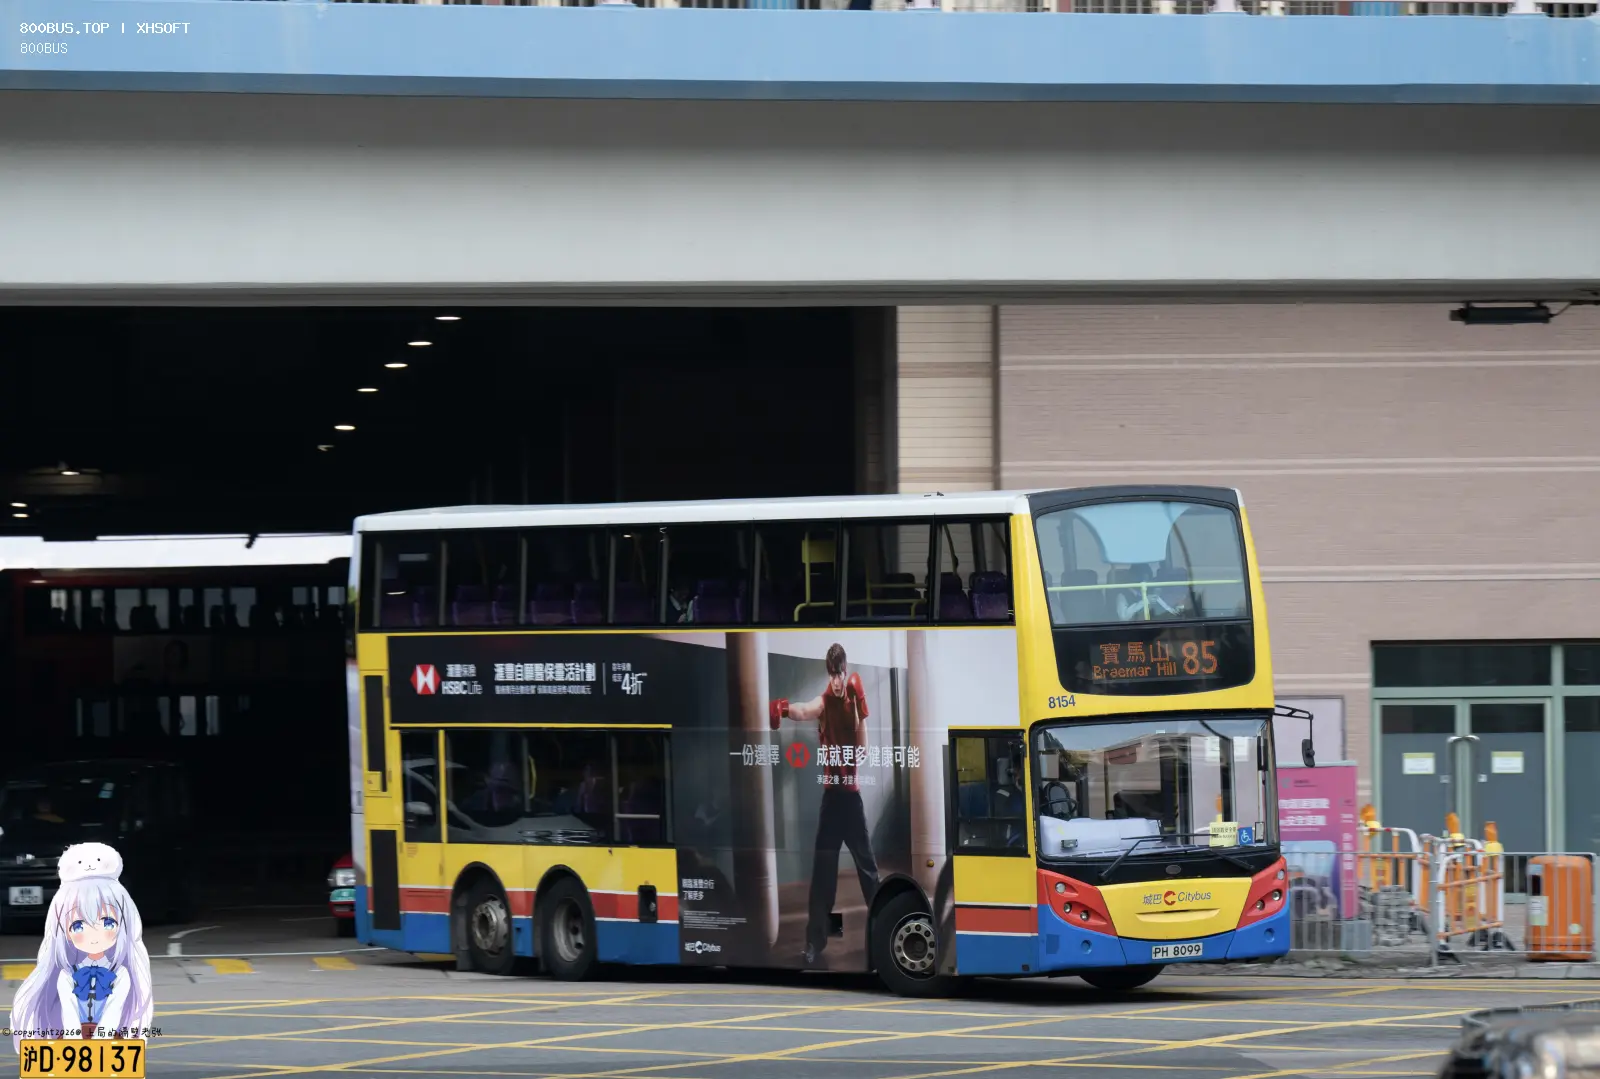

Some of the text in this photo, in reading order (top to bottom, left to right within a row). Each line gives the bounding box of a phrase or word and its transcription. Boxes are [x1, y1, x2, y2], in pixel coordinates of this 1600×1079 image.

[1100, 641, 1170, 665] 寶馬山
[1182, 640, 1218, 675] 85
[1093, 662, 1177, 680] Braemar Hill
[441, 680, 468, 695] HSBC
[1048, 695, 1076, 709] 8154
[729, 743, 921, 768] 一份選擇 成就更多健康可能
[1143, 891, 1212, 905] 城巴 Citybus
[1153, 944, 1202, 958] PH 8099
